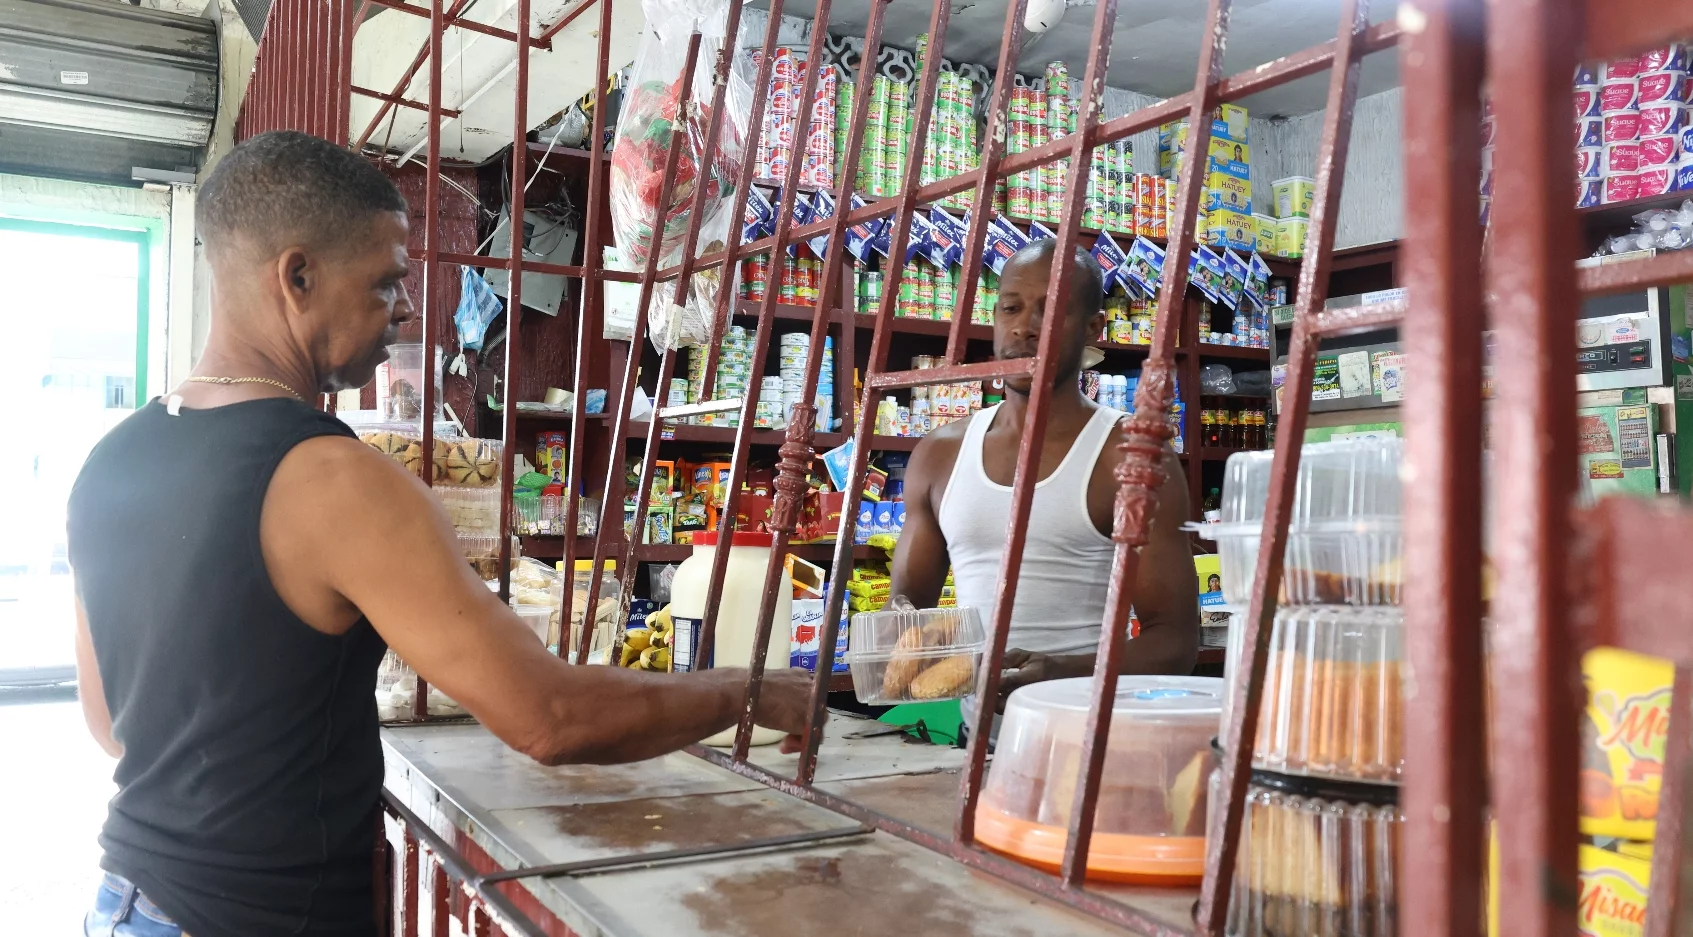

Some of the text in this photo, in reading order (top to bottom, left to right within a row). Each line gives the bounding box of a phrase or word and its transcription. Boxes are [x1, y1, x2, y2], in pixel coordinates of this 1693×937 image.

[1611, 118, 1635, 126] Suave
[1221, 181, 1246, 194] HATUEY
[1226, 218, 1252, 230] HATUEY
[630, 613, 647, 621] Mile
